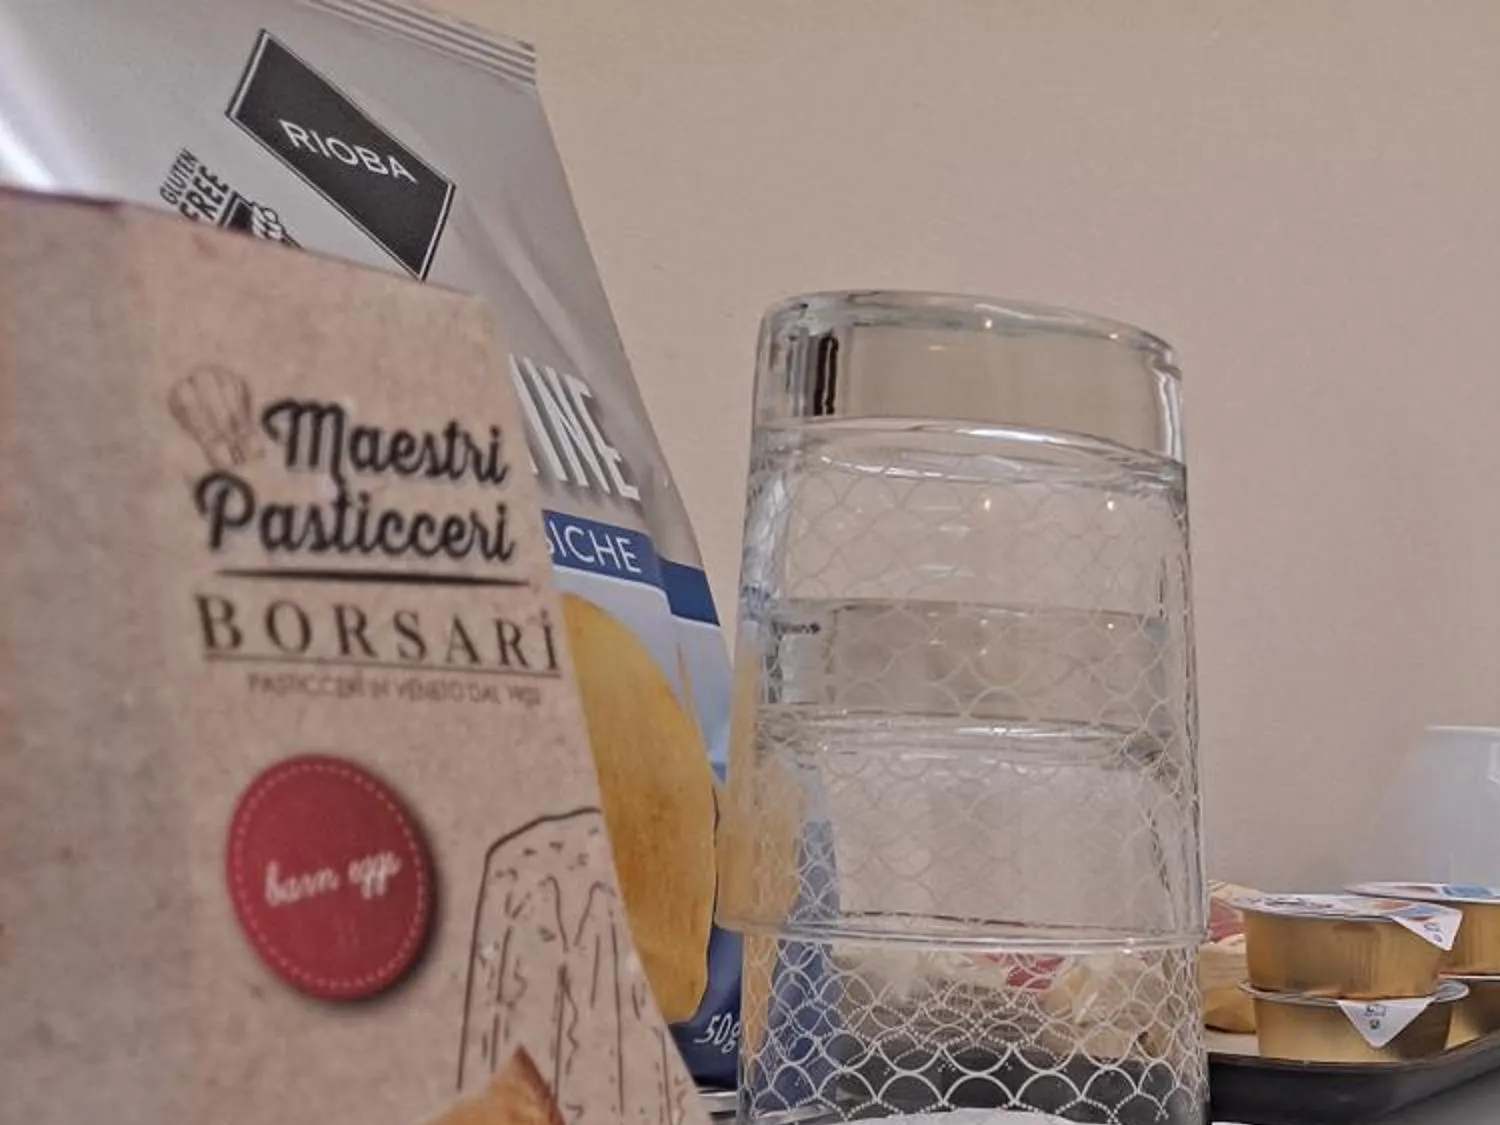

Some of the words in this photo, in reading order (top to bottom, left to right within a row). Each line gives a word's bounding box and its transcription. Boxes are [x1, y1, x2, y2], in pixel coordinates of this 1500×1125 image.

[158, 147, 198, 205] GLUTEN
[278, 118, 418, 184] RIOBA
[261, 398, 510, 485] Maestri
[194, 466, 518, 562] Pasticceri
